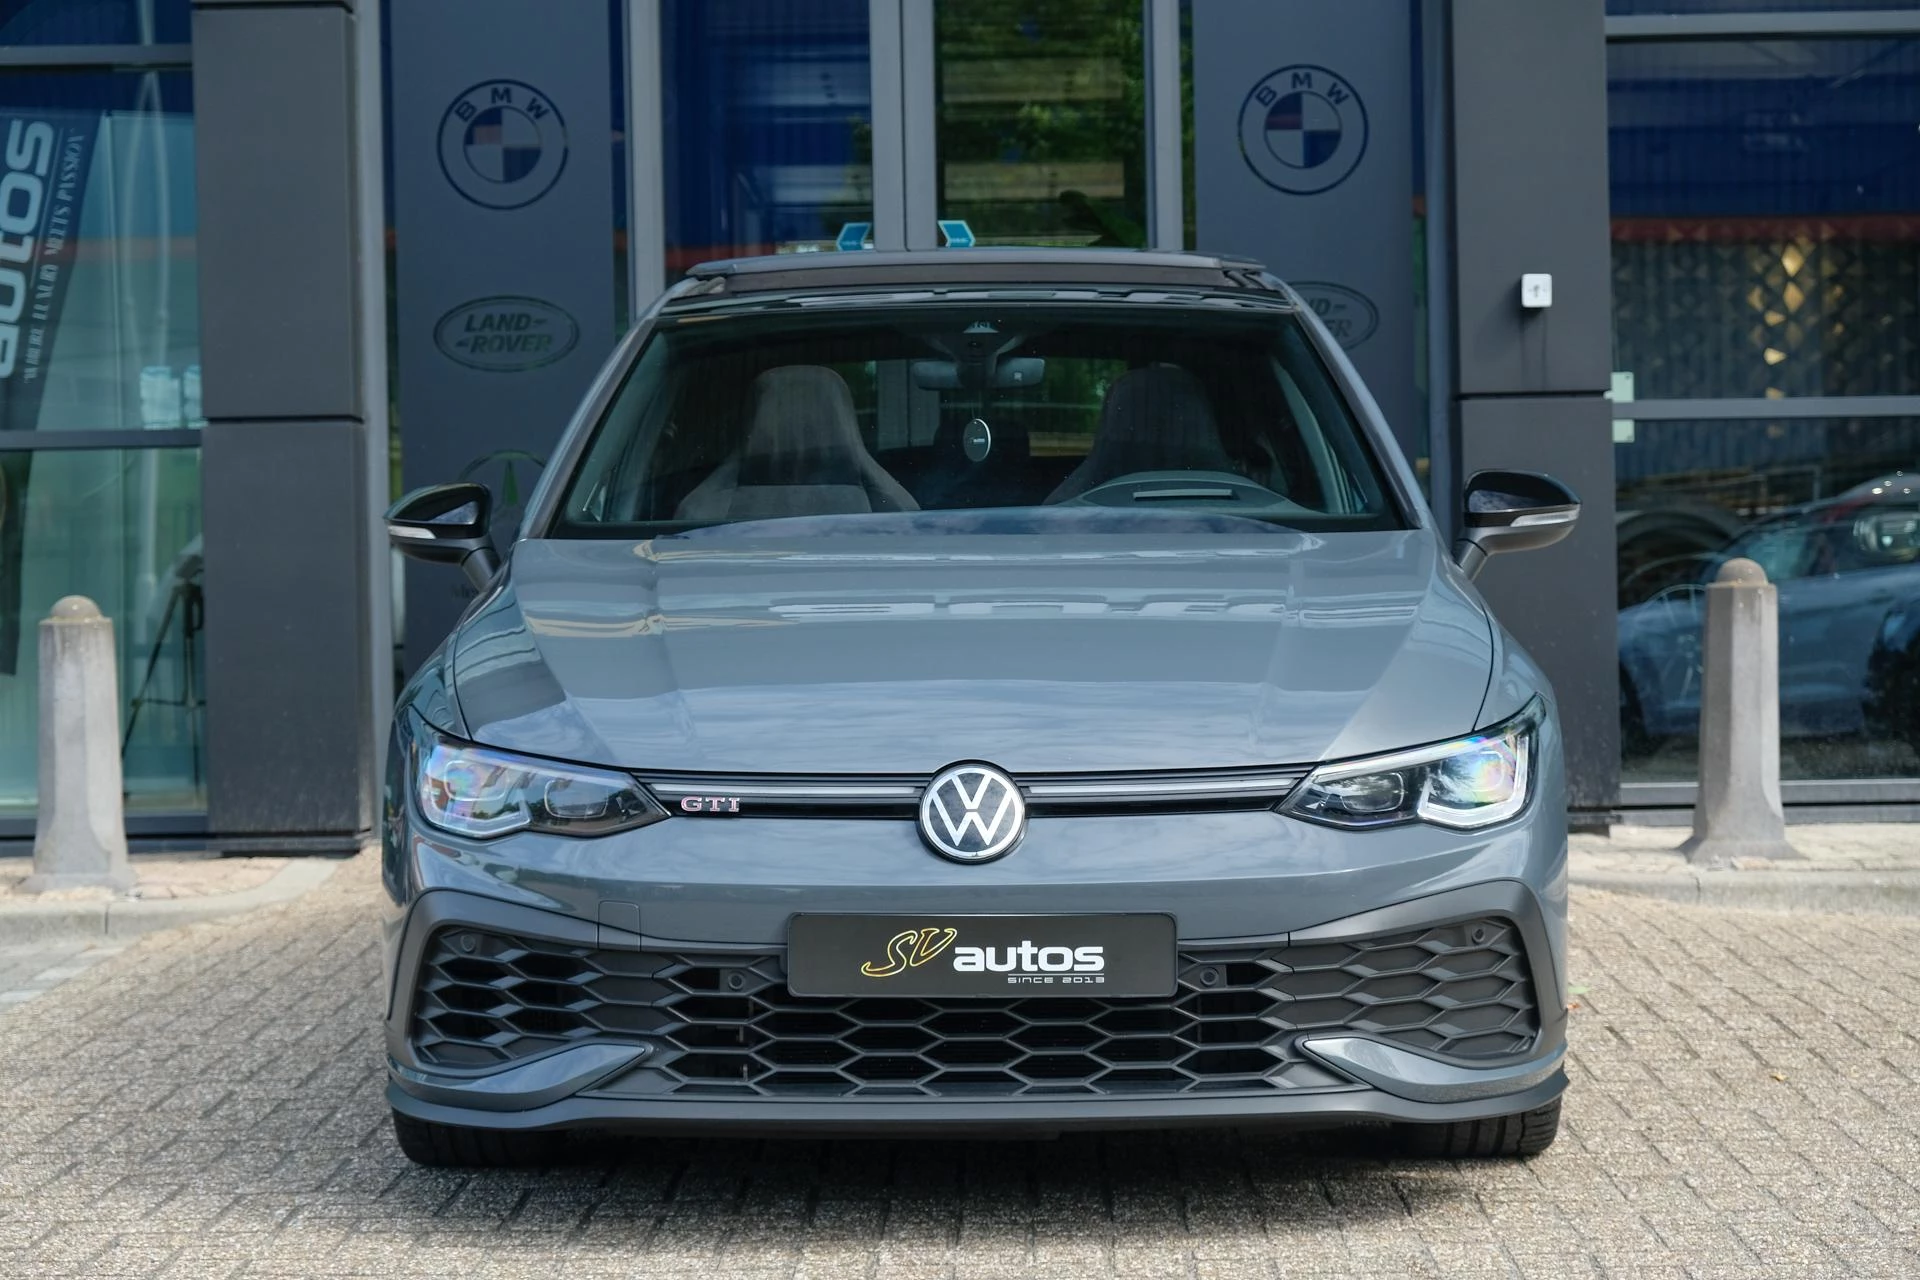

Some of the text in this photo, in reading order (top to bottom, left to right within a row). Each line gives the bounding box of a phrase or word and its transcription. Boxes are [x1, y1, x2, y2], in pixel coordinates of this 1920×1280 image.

[1255, 72, 1349, 108] BMW
[454, 87, 549, 123] BMW
[464, 313, 532, 333] LAND
[470, 334, 553, 353] ROVER
[680, 796, 740, 812] GTI
[953, 940, 1105, 973] autos
